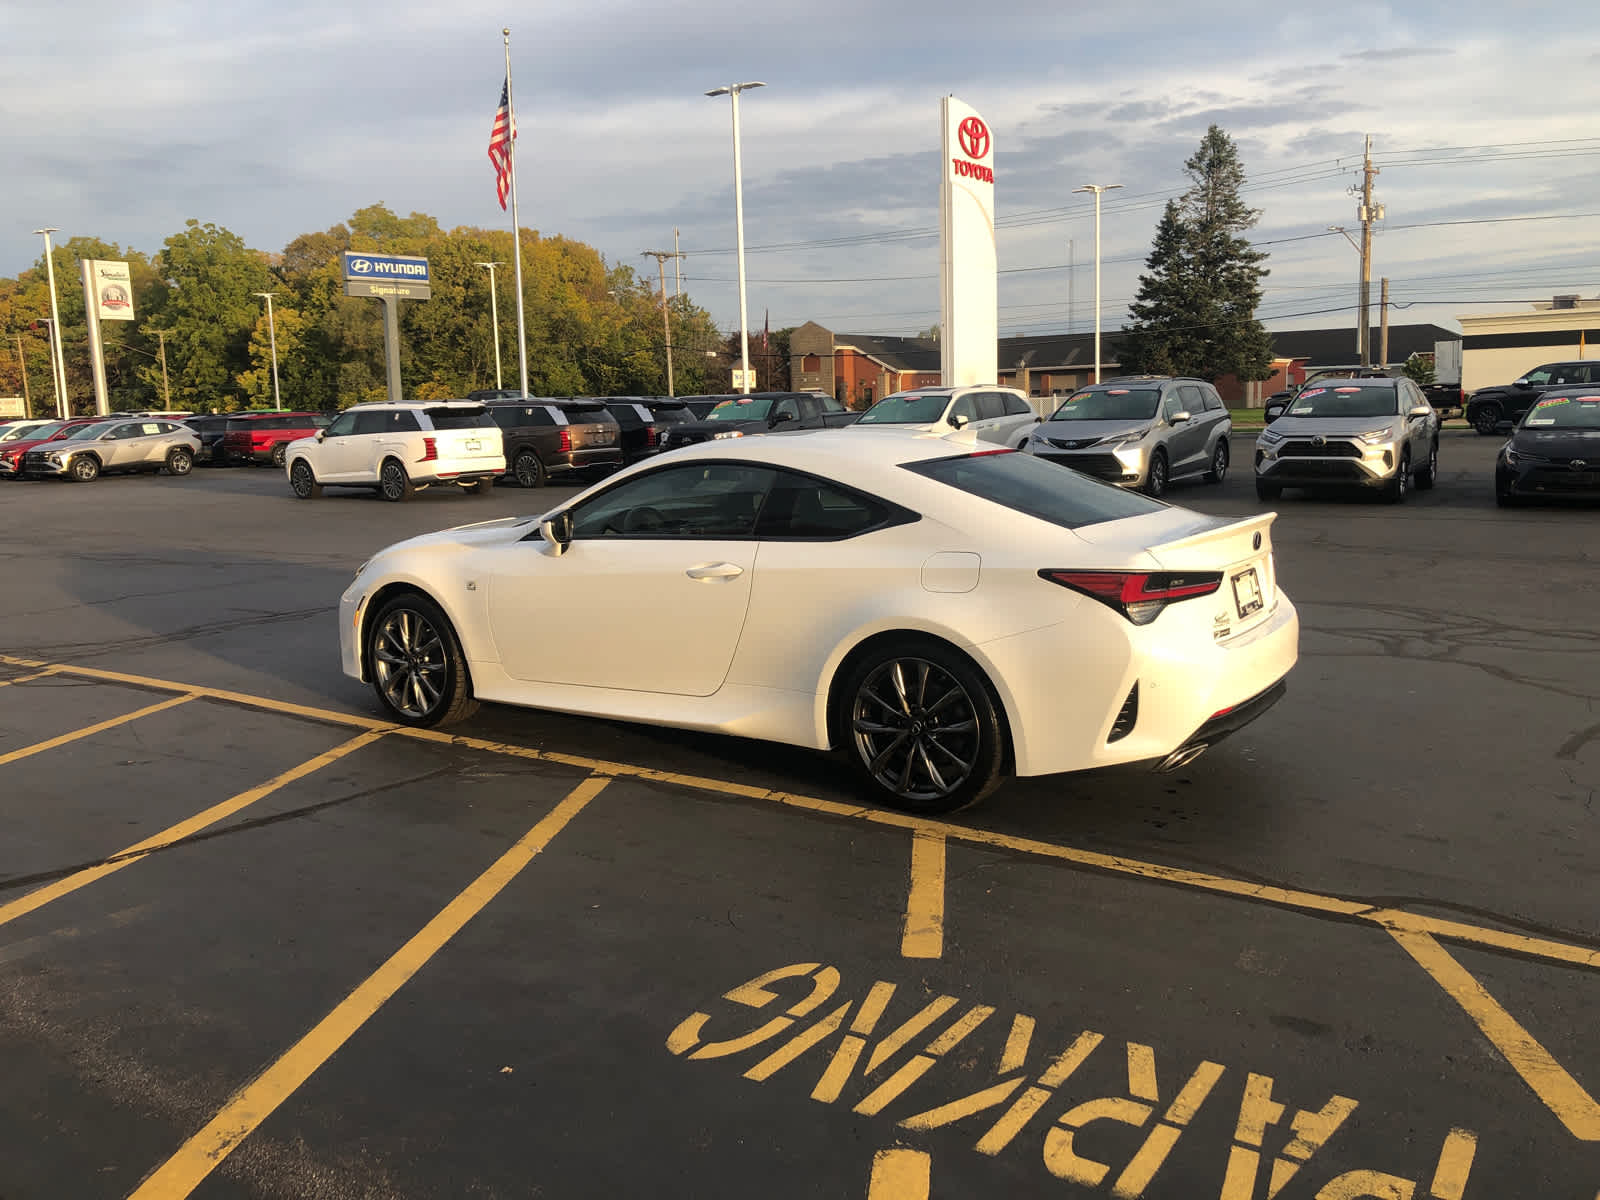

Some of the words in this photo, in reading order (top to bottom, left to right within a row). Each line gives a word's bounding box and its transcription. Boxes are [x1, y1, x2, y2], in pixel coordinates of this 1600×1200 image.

[952, 158, 994, 184] TOYOTA
[374, 262, 425, 275] HYUNDAI
[370, 285, 410, 296] Signature
